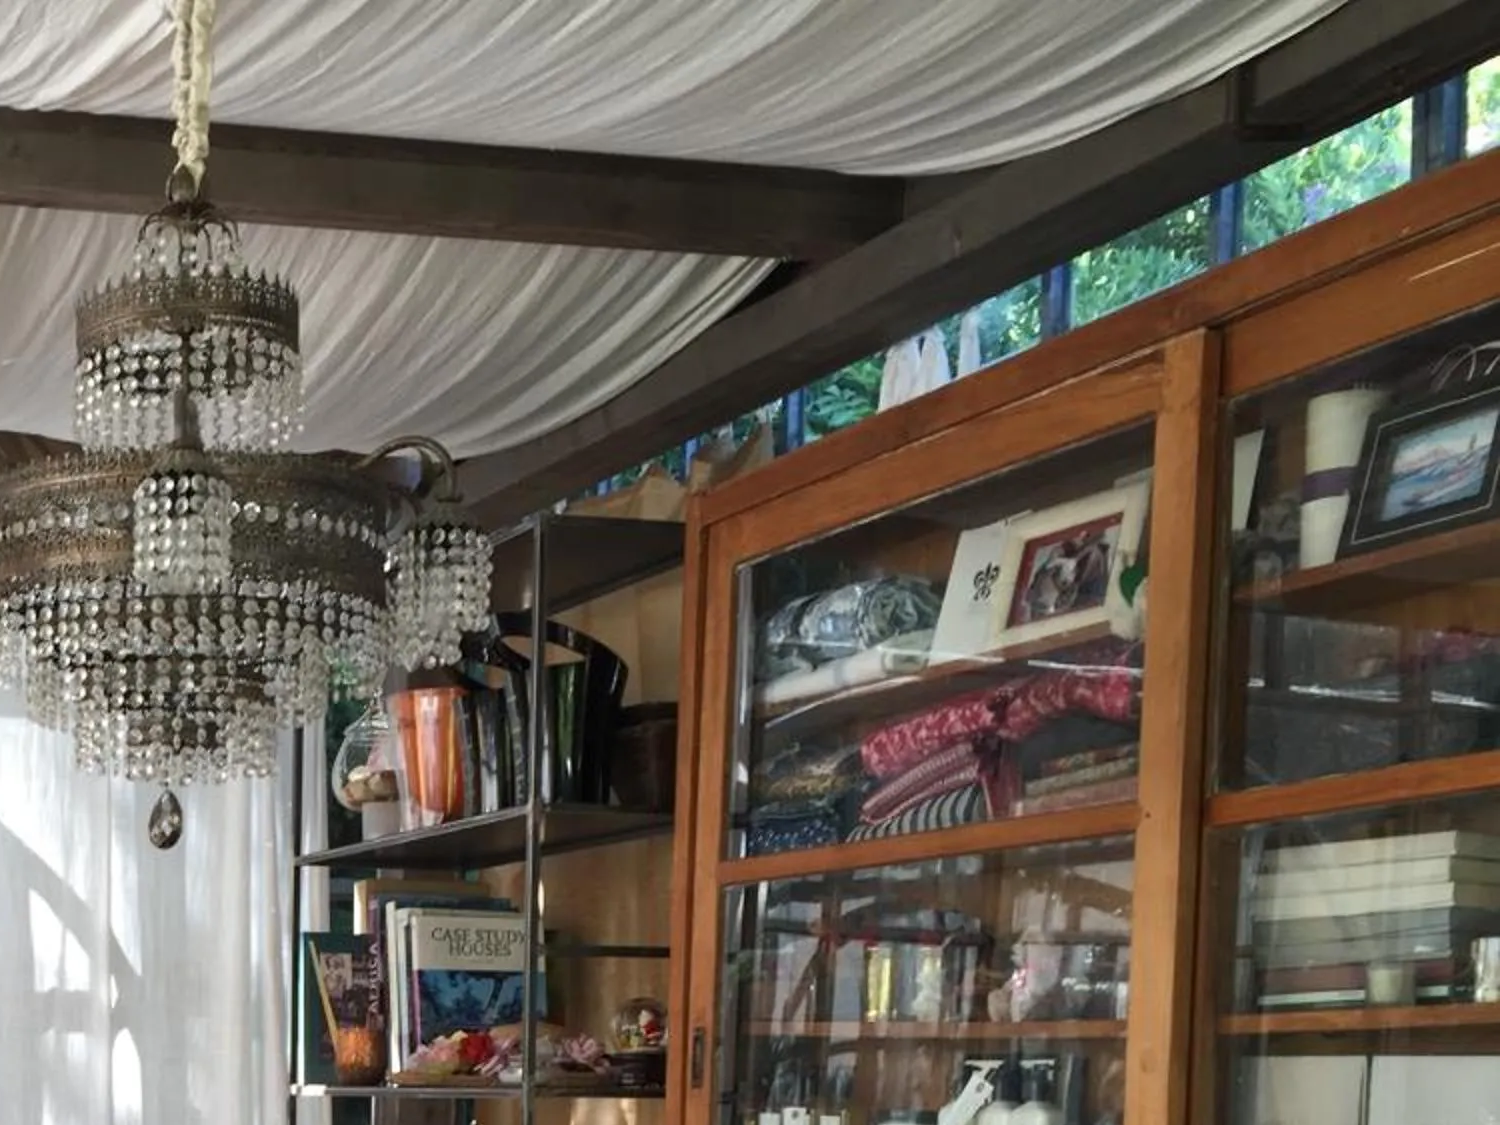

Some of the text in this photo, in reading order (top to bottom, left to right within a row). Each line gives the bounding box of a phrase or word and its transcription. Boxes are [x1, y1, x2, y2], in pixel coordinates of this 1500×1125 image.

[431, 927, 526, 944] CASE STUDY
[449, 942, 512, 957] HOUSES
